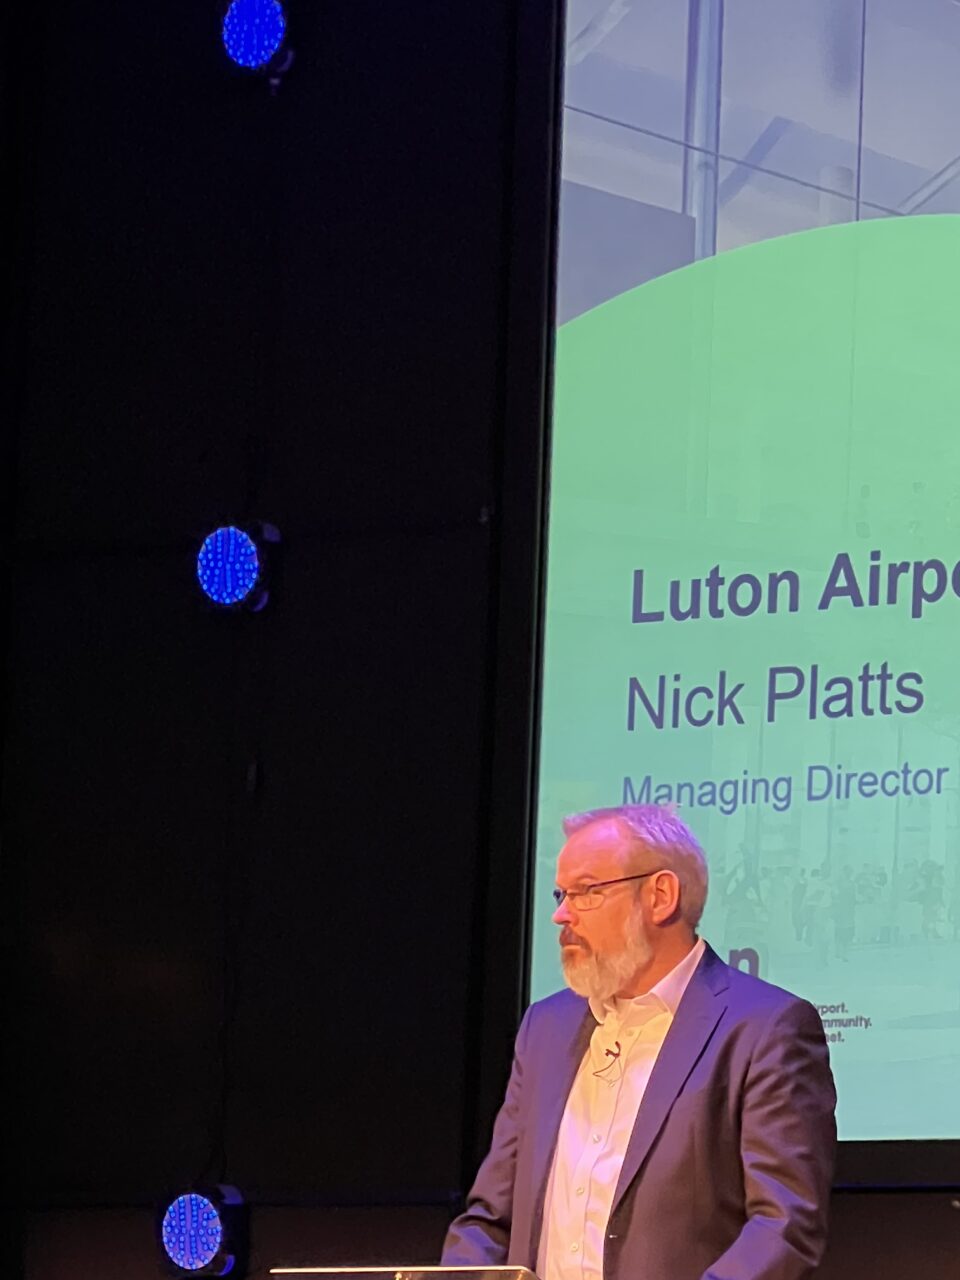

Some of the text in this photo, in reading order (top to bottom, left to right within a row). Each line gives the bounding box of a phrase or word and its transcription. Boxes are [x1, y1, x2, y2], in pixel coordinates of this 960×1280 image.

[631, 565, 800, 624] Luton
[627, 661, 924, 731] Nick Platts
[622, 762, 950, 815] Managing Director
[815, 1002, 849, 1016] rport.
